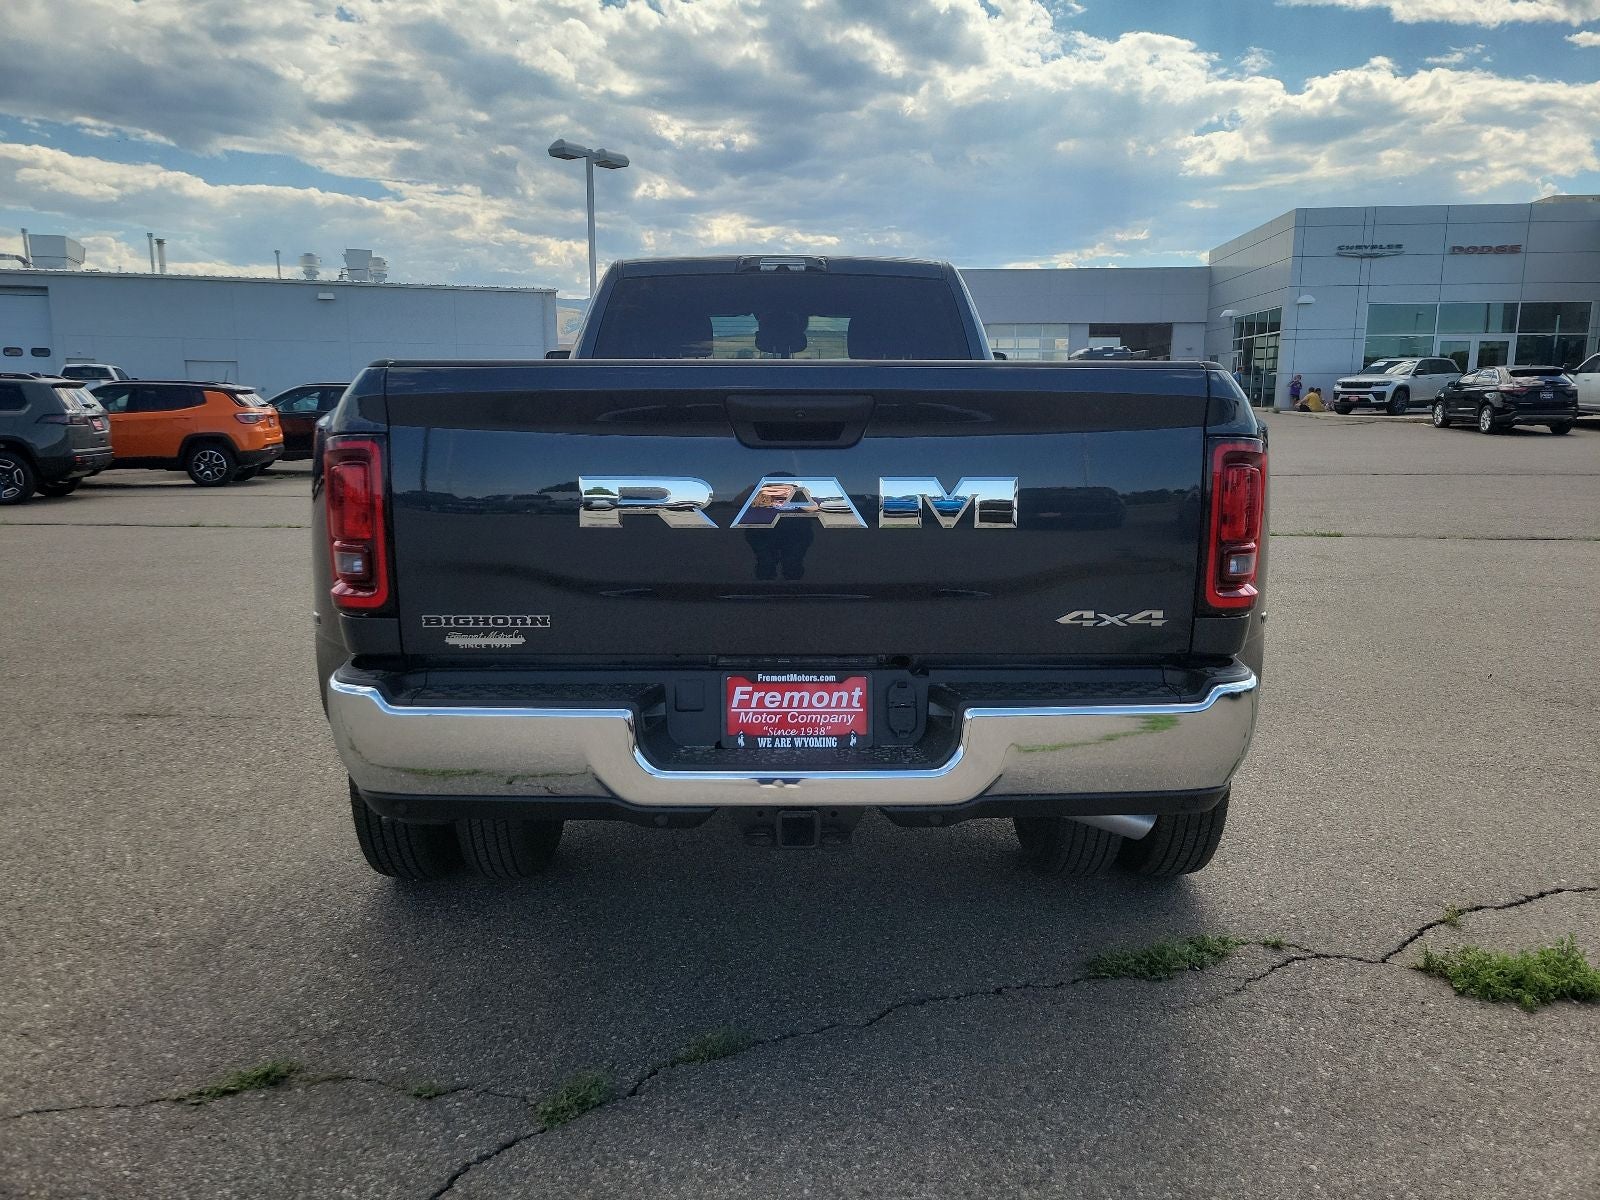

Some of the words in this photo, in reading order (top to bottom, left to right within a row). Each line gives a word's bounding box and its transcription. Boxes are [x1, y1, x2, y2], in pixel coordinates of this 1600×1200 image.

[1450, 244, 1522, 255] DODGE
[579, 475, 1019, 529] RAM
[422, 614, 551, 628] BIGHORN
[1055, 609, 1169, 627] 4x4
[757, 673, 836, 682] FremontMotors.com
[731, 686, 863, 708] Fremont
[739, 711, 782, 723] Motor
[787, 711, 856, 725] Company
[757, 737, 773, 748] WE
[774, 737, 791, 748] ARE
[793, 736, 838, 748] WYOMING
